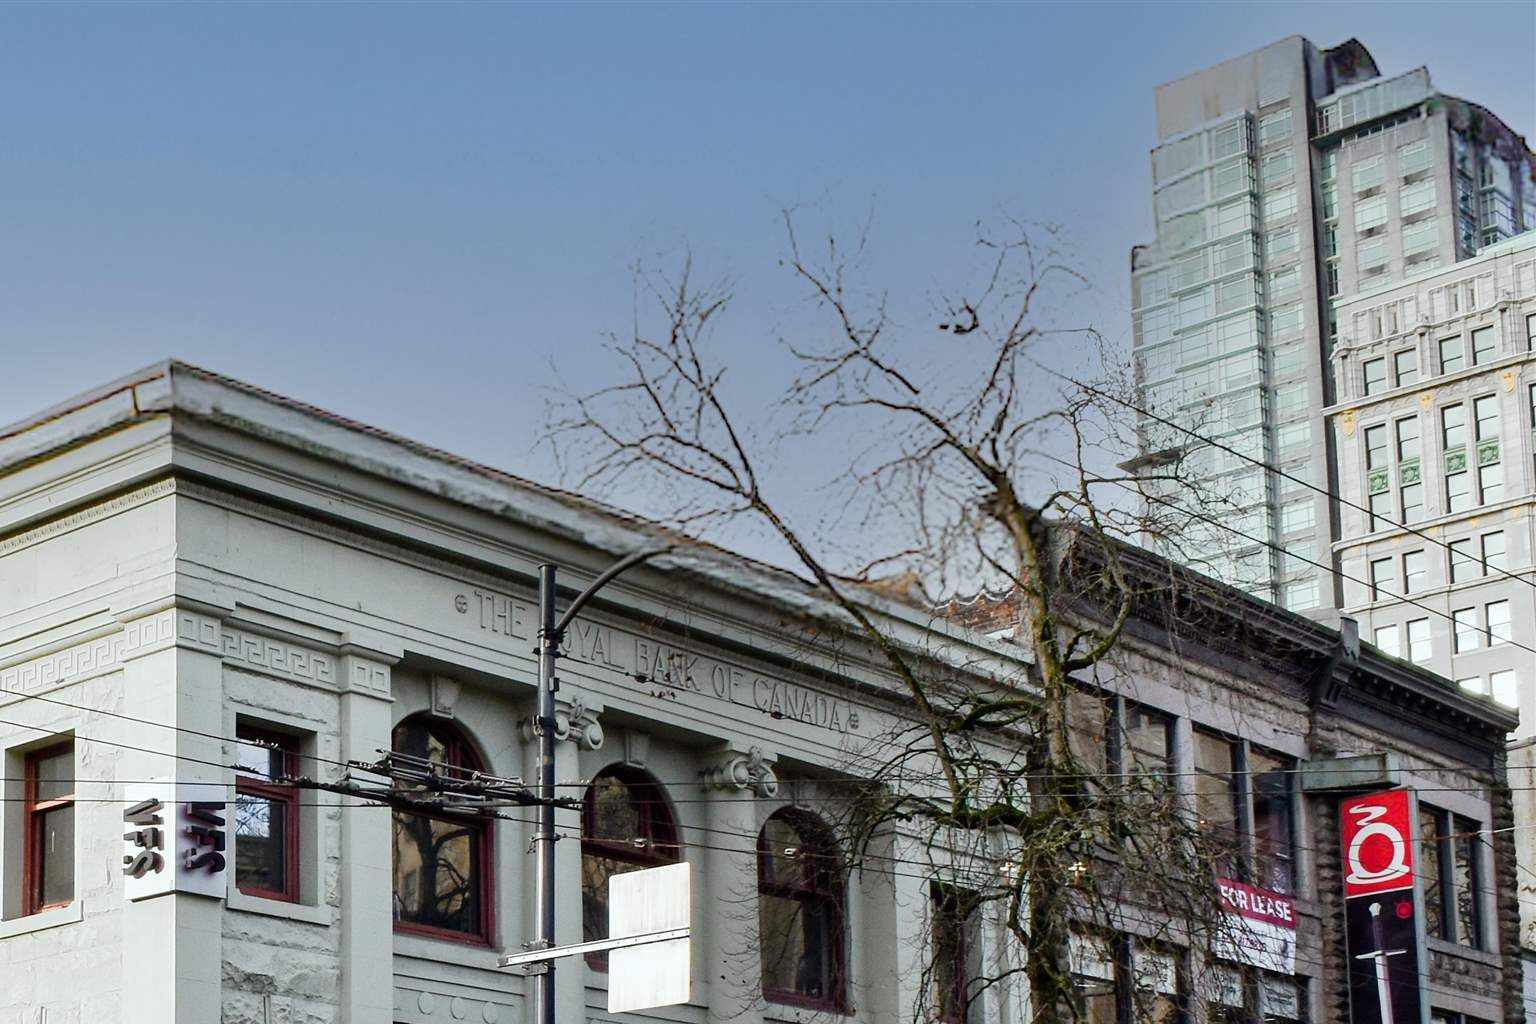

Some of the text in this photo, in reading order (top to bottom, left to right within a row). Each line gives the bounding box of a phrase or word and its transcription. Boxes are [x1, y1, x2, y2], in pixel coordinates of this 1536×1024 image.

[473, 590, 847, 734] THE OYAL BANK OF CANADA
[1220, 884, 1293, 922] FOR LEASE
